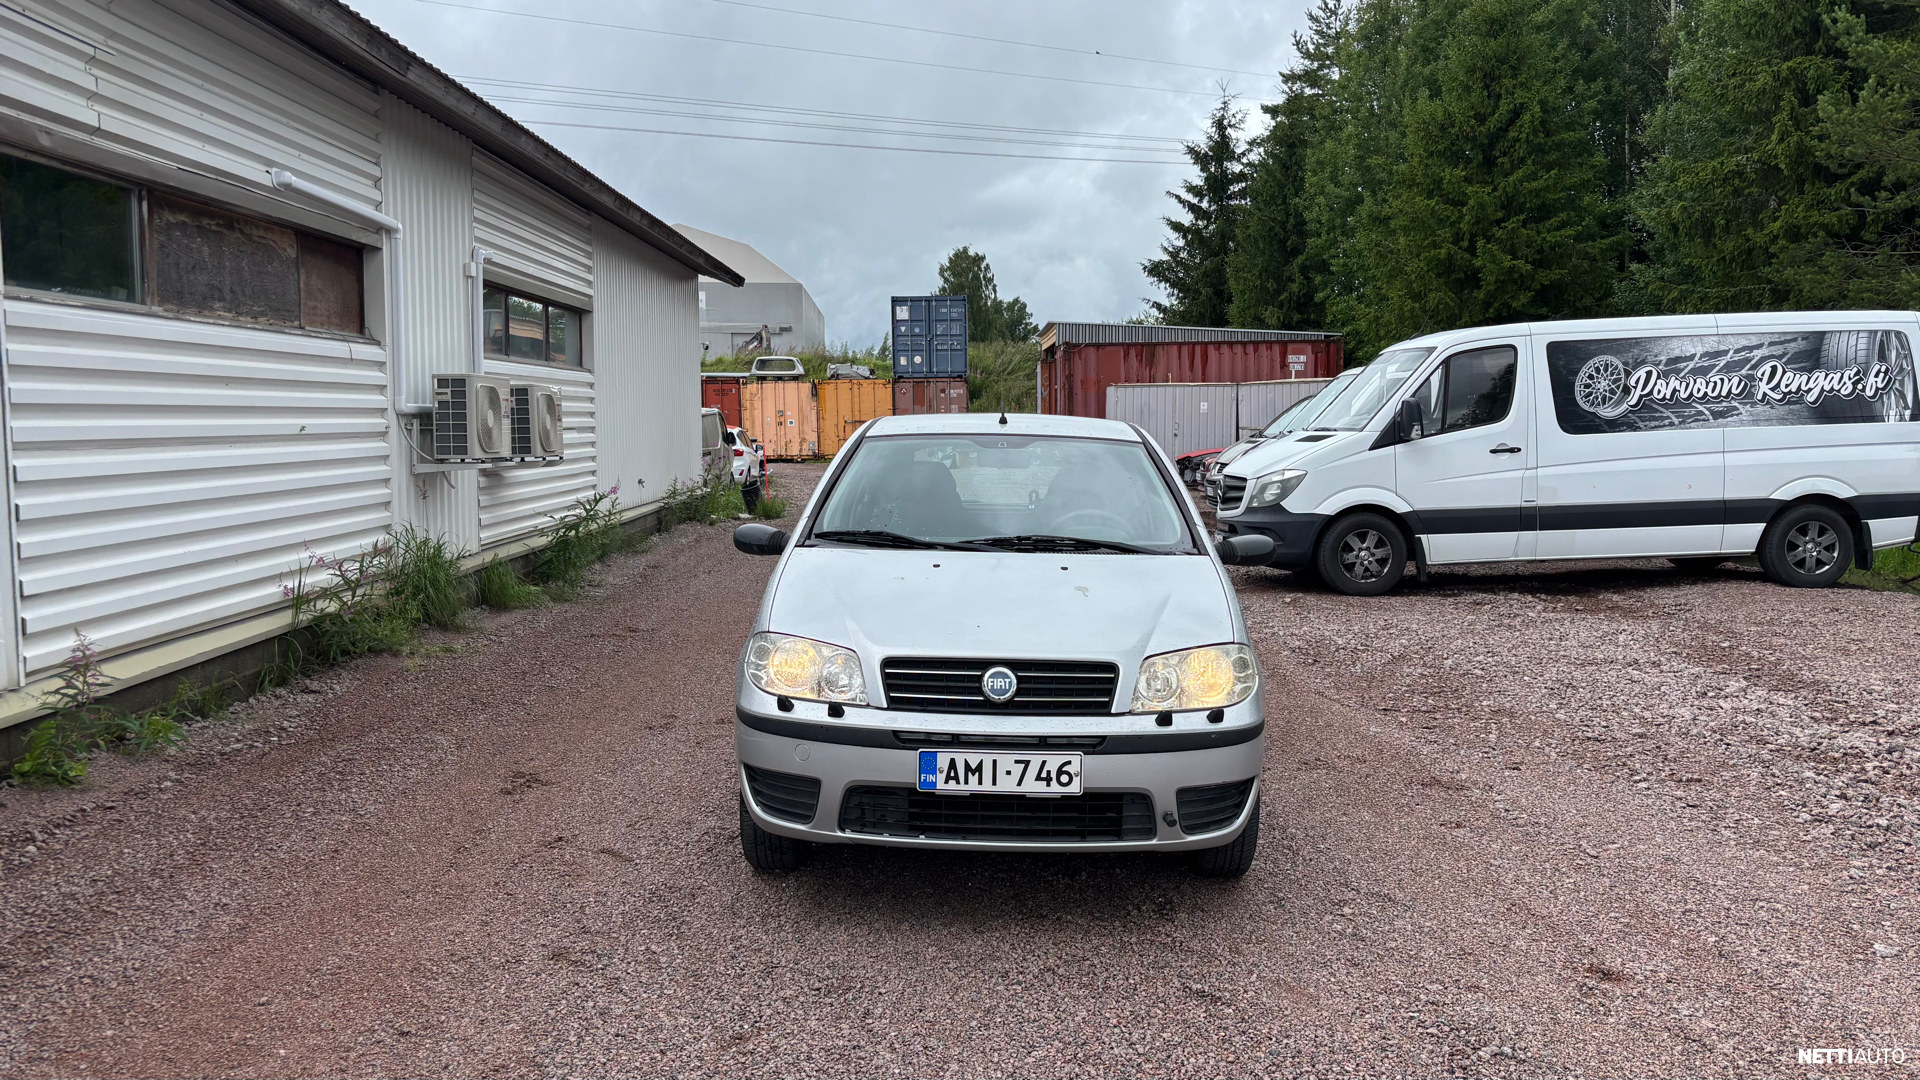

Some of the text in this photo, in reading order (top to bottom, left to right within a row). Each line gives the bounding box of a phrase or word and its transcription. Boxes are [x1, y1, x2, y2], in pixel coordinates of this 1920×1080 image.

[1626, 360, 1891, 407] Porvoon Rengas.fi
[988, 678, 1011, 690] FIAT
[920, 774, 936, 783] FIN
